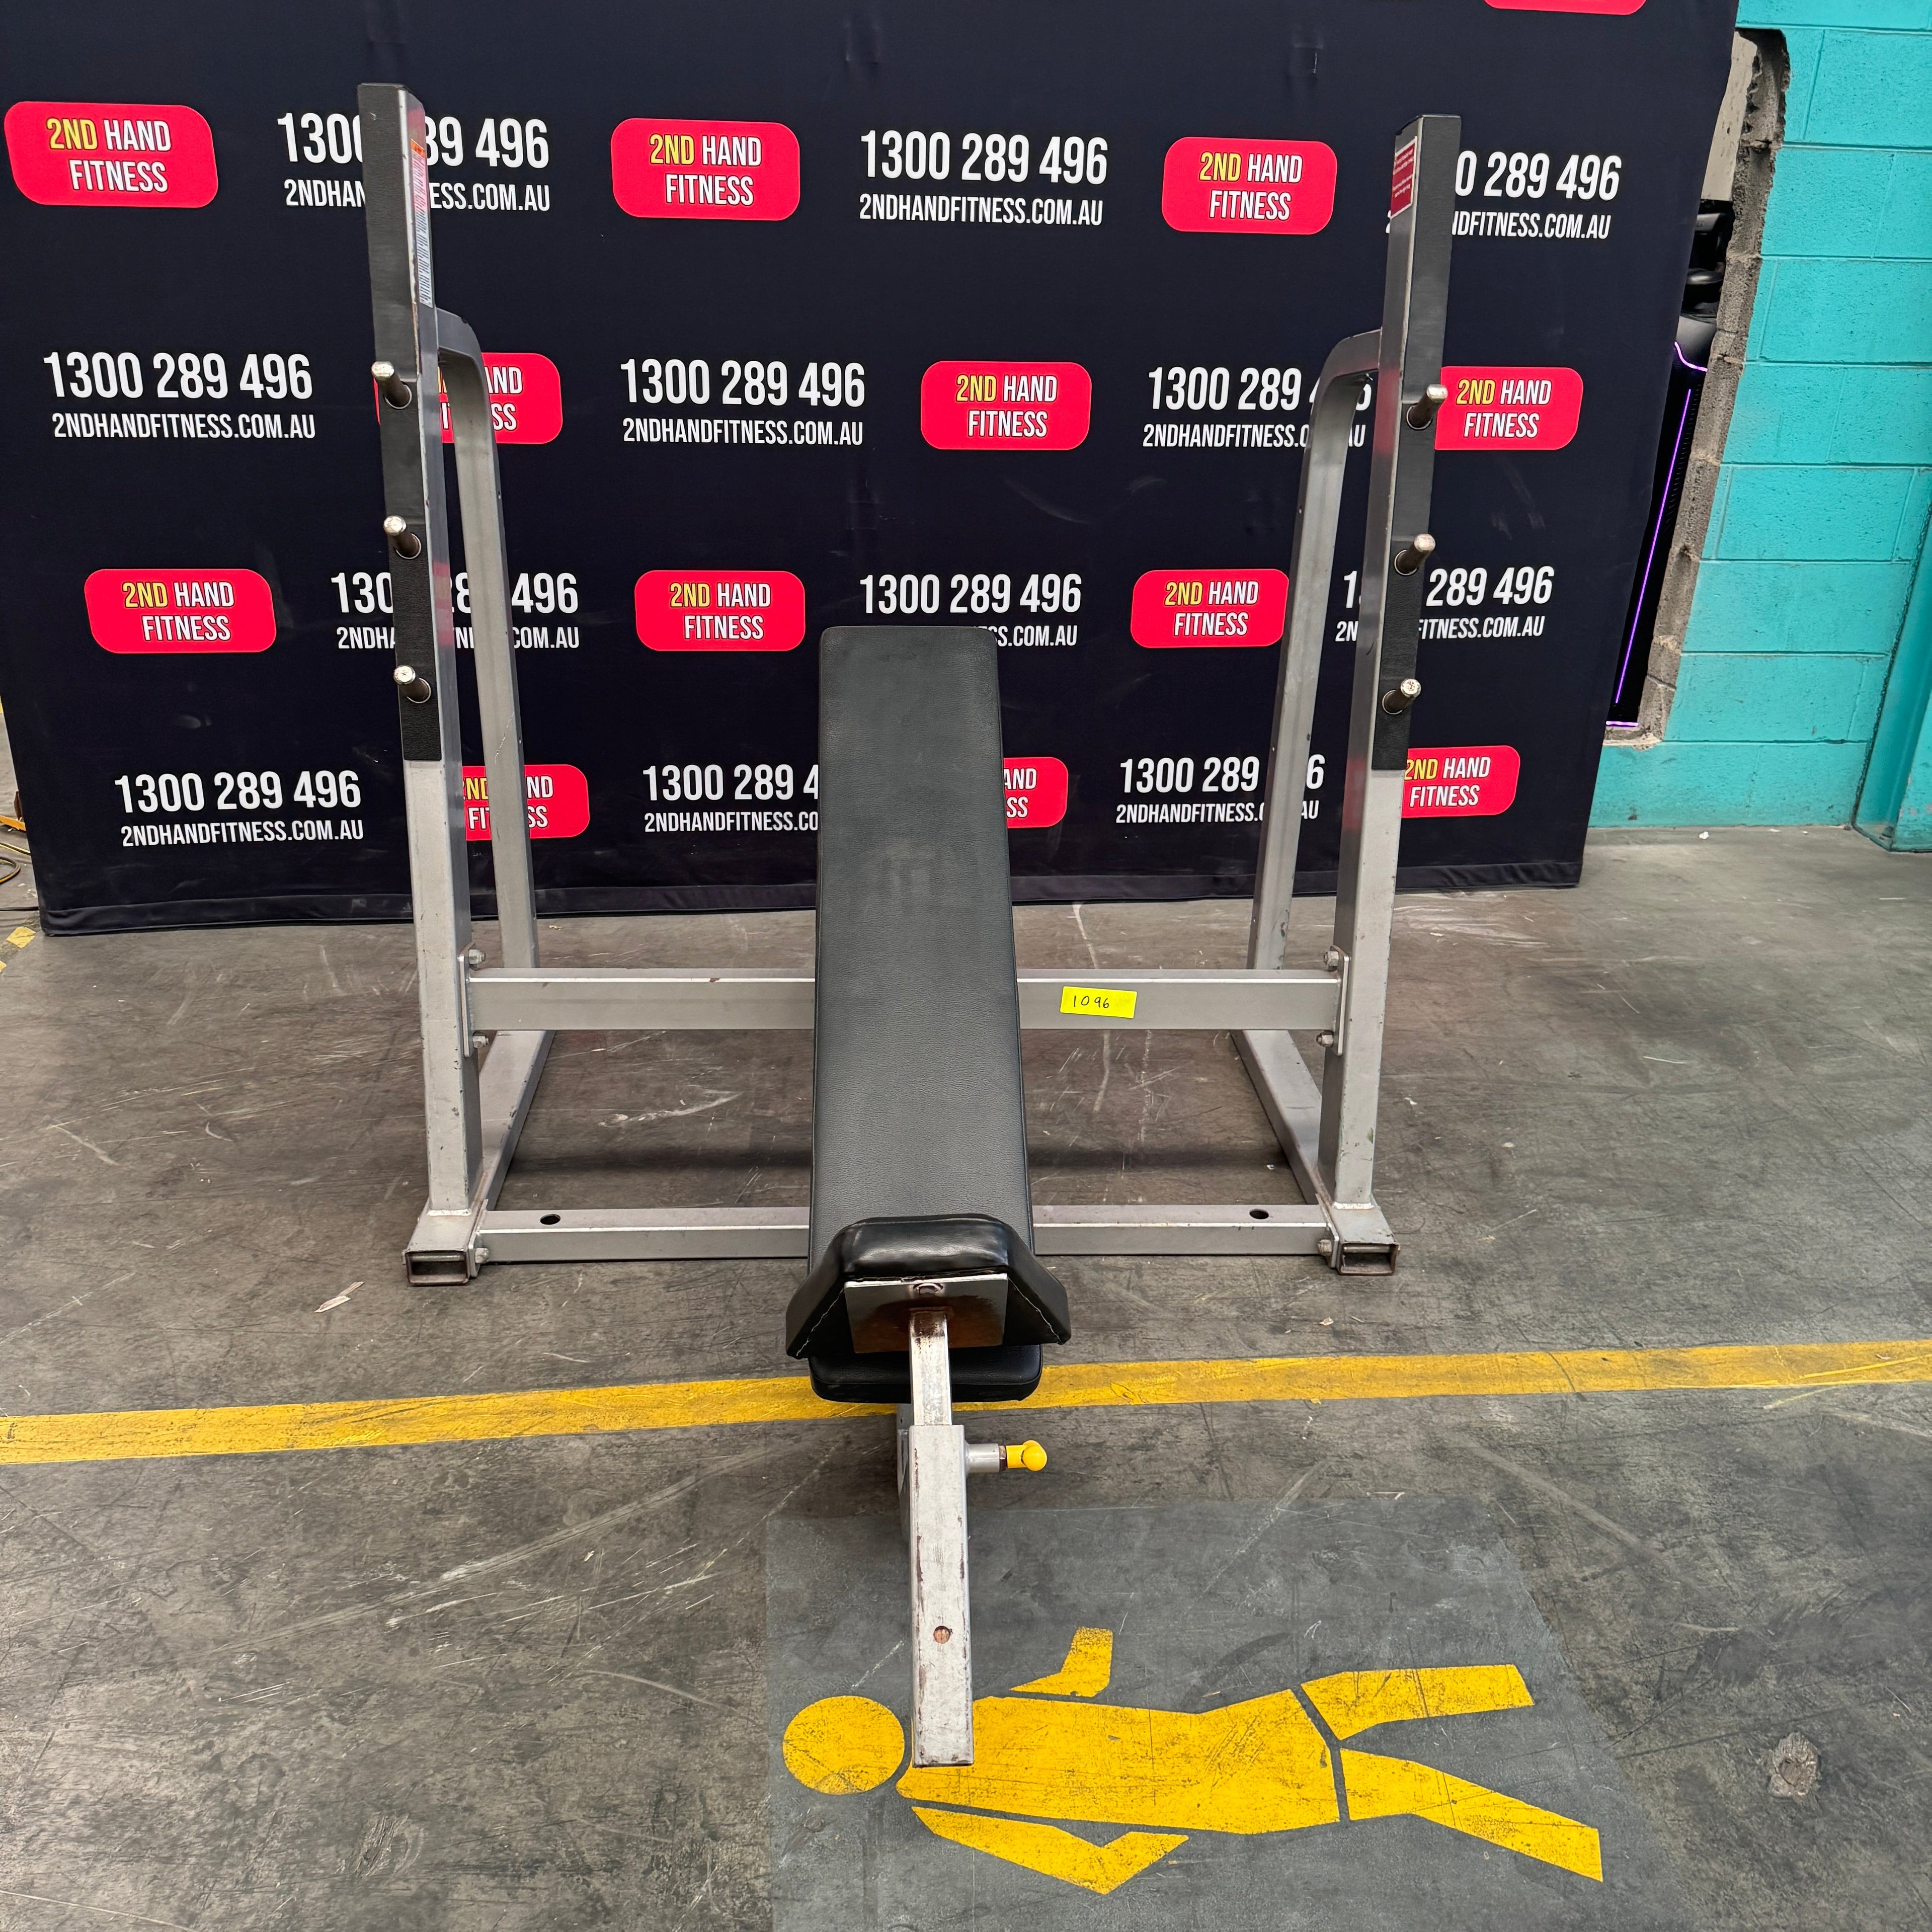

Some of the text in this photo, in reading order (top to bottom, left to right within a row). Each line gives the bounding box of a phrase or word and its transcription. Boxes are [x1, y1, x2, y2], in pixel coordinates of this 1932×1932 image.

[47, 118, 171, 151] 2ND HAND
[475, 118, 549, 169] 496
[650, 134, 761, 166] 2ND HAND
[861, 130, 1108, 185] 1300 289 496
[69, 159, 168, 192] FITNESS
[1199, 152, 1303, 183] 2ND HAND
[1483, 151, 1550, 198] 289
[1556, 154, 1622, 201] 496
[284, 179, 550, 212] 2NDHANESS.COM.AU
[666, 174, 753, 205] FITNESS
[859, 193, 1103, 226] 2NDHANDFITNESS.COM.AU
[1210, 190, 1291, 220] FITNESS
[43, 351, 312, 399] 1300 289 496
[620, 358, 865, 407] 1300 289 496
[956, 374, 1057, 402] 2ND HAND
[1149, 366, 1230, 411] 1300
[1238, 367, 1302, 411] 289
[1456, 379, 1552, 405] 2ND HAND
[52, 413, 315, 439] 2NDHANDFITNESS.COM.AU
[623, 418, 863, 445] 2NDHANDFITNESS.COM.AU
[969, 410, 1048, 437] FITNESS
[1464, 413, 1540, 438] FITNESS
[123, 582, 234, 607] 2ND HAND
[331, 572, 393, 614] 130
[511, 572, 579, 614] 496
[670, 583, 770, 607] 2ND HAND
[860, 573, 1082, 614] 1300 289 496
[1165, 581, 1259, 605] 2ND HAND
[1426, 566, 1555, 606] 289 496
[142, 615, 230, 640] FITNESS
[685, 615, 763, 639] FITNESS
[1174, 612, 1248, 636] FITNESS
[642, 764, 723, 801] 1300
[734, 764, 793, 800] 289
[1004, 768, 1037, 790] AND
[1120, 756, 1260, 793] 1300 289
[1404, 756, 1491, 780] 2ND HAND
[114, 770, 361, 813] 1300 289 496
[463, 777, 489, 800] ND
[1410, 784, 1480, 807] FITNESS
[121, 820, 364, 847] 2NDHANDFITNESS.COM.AU
[1074, 995, 1109, 1009] 1096
